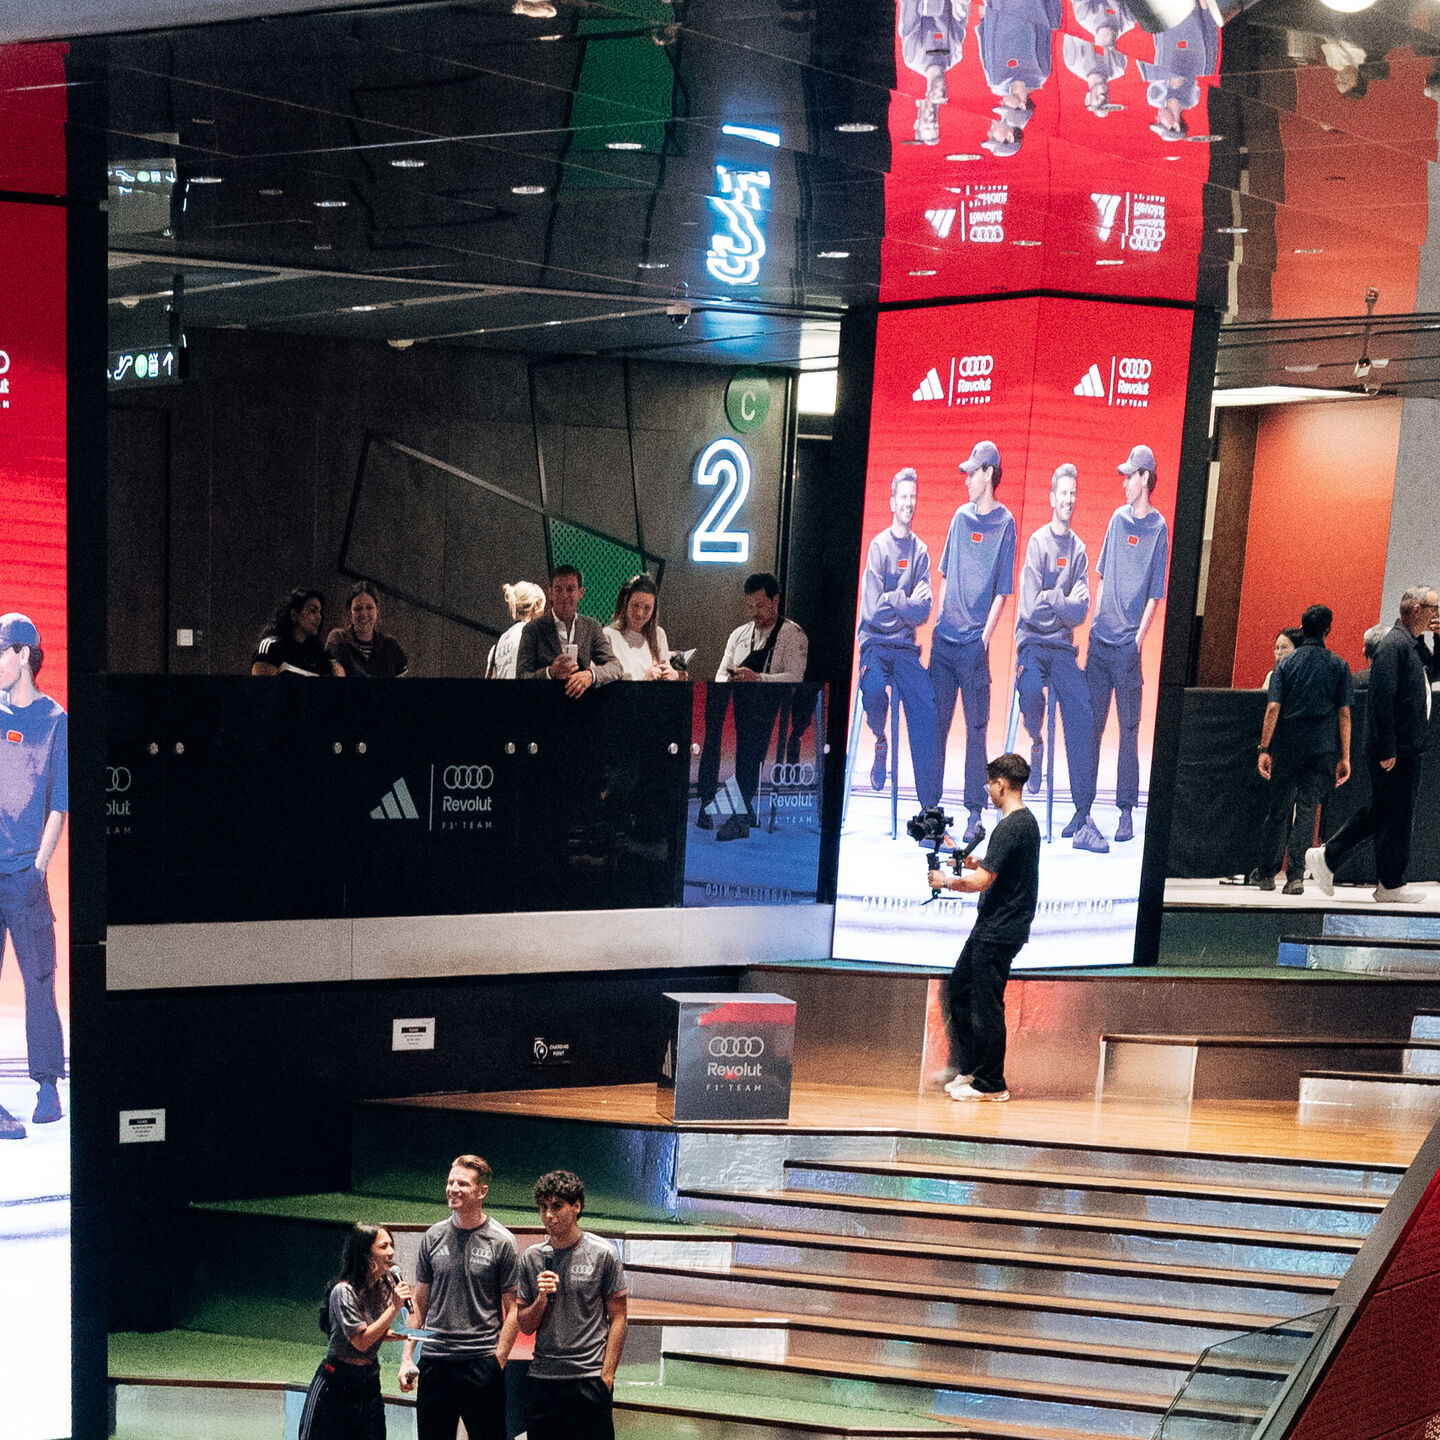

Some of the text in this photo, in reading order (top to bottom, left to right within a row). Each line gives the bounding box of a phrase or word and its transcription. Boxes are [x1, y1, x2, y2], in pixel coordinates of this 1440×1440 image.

[957, 378, 992, 393] Revolut
[1117, 379, 1150, 396] Revolut
[692, 436, 751, 563] 2
[106, 799, 131, 815] olut
[442, 795, 493, 812] Revolut
[769, 792, 813, 807] Revolut
[462, 821, 492, 830] TEAM
[862, 895, 913, 913] GABRIEL
[934, 898, 963, 915] NICO
[1035, 901, 1066, 916] RIEL
[1086, 898, 1113, 914] NICO
[707, 1062, 762, 1077] Revolut
